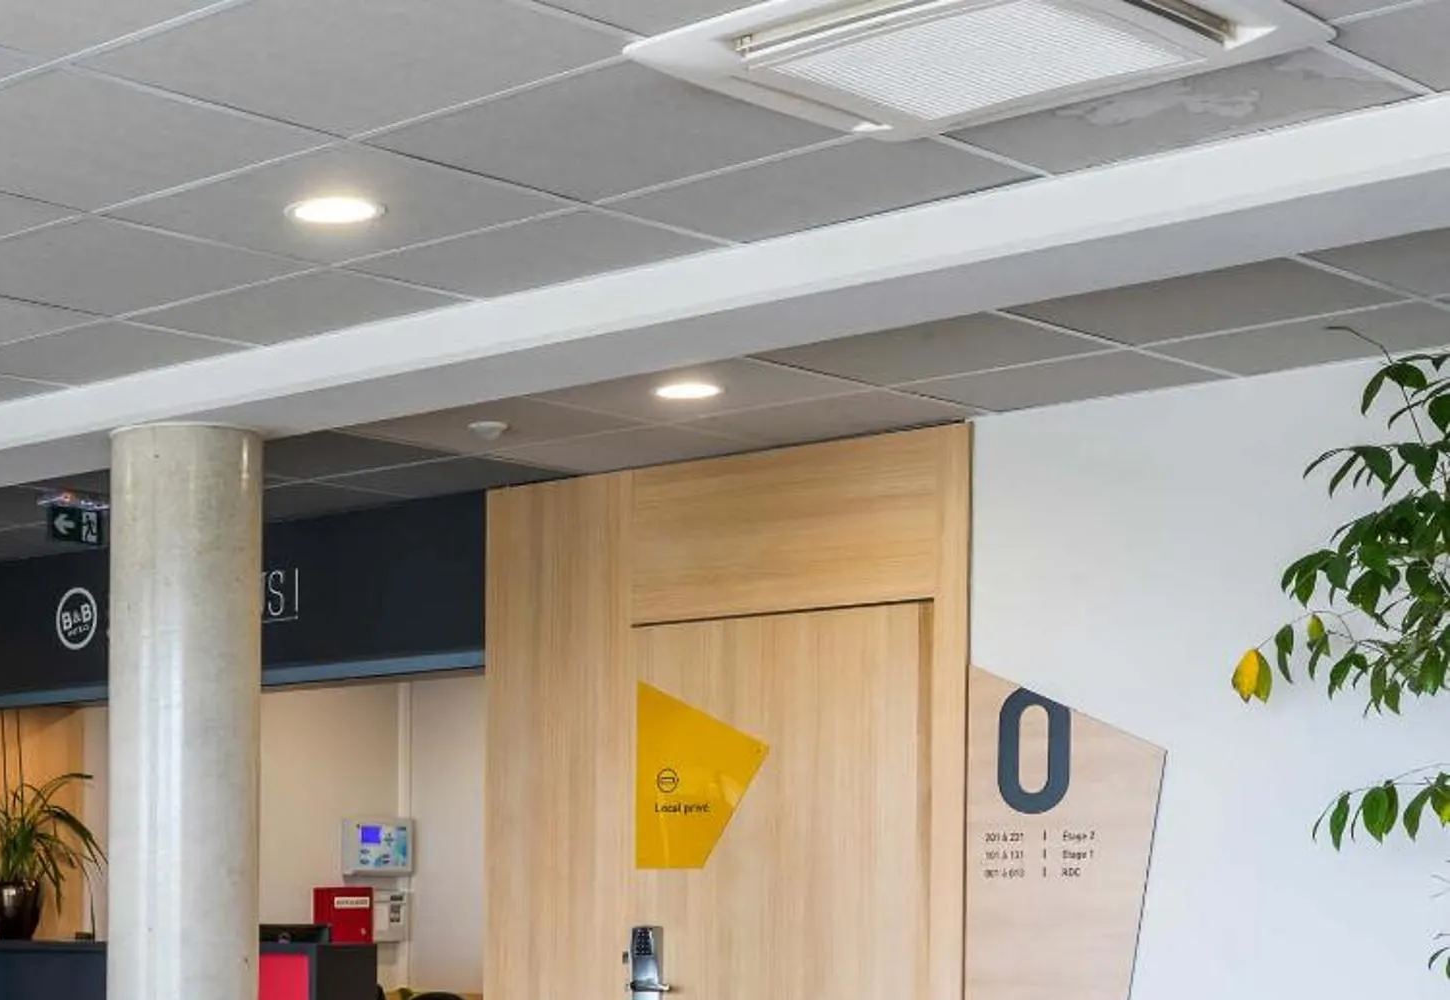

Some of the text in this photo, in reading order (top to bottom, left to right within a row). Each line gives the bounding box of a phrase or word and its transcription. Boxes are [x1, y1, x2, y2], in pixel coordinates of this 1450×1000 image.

[61, 603, 92, 631] B&B
[997, 686, 1071, 815] 0
[654, 801, 681, 813] Local
[1062, 867, 1081, 877] RDC
